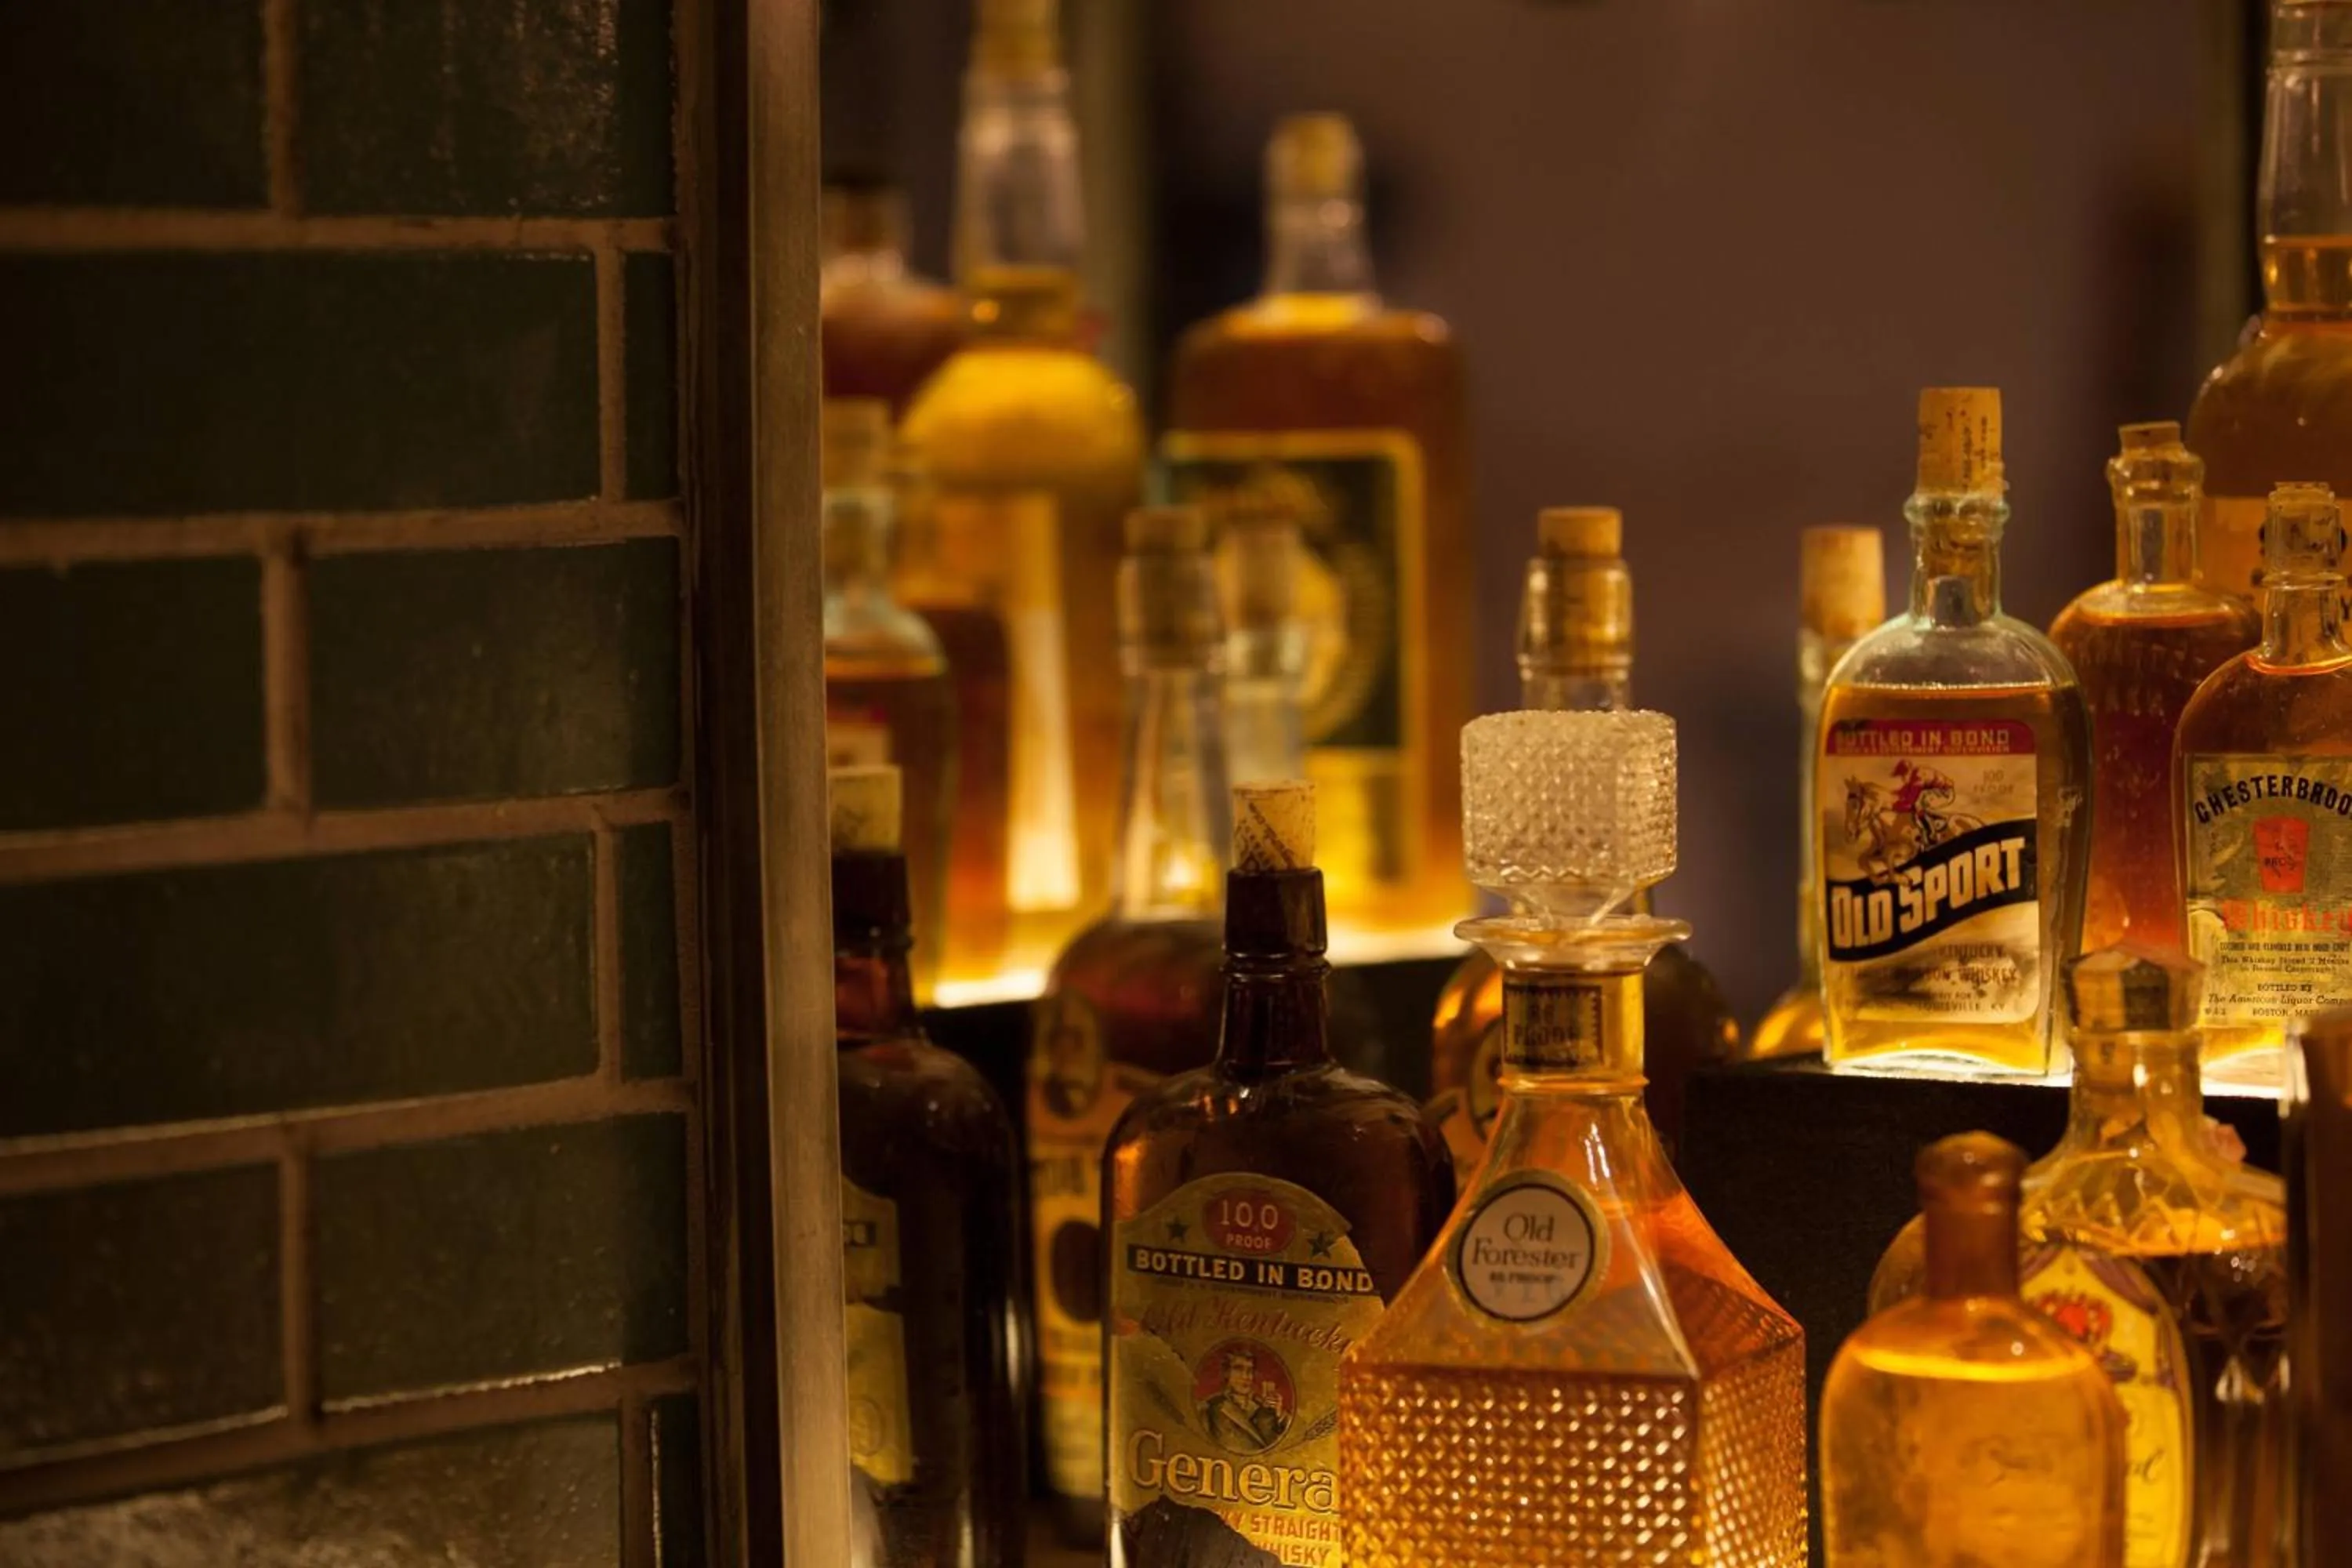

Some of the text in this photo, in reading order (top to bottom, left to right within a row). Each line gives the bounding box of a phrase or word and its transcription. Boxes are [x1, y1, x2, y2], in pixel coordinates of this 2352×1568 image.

[1835, 728, 2010, 746] BOTTLED IN BOND
[1983, 769, 2005, 782] 100
[2194, 775, 2352, 824] CHESTERBROO
[1831, 837, 2026, 949] OLD SPORT
[2209, 994, 2226, 1003] The
[1220, 1200, 1279, 1230] 100
[1503, 1211, 1555, 1243] Old
[1225, 1234, 1273, 1250] PROOF
[1472, 1236, 1582, 1269] Forester
[1135, 1249, 1246, 1281] BOTTLED
[1258, 1264, 1284, 1286] IN
[1298, 1268, 1374, 1294] BOND
[1128, 1429, 1341, 1514] Genera
